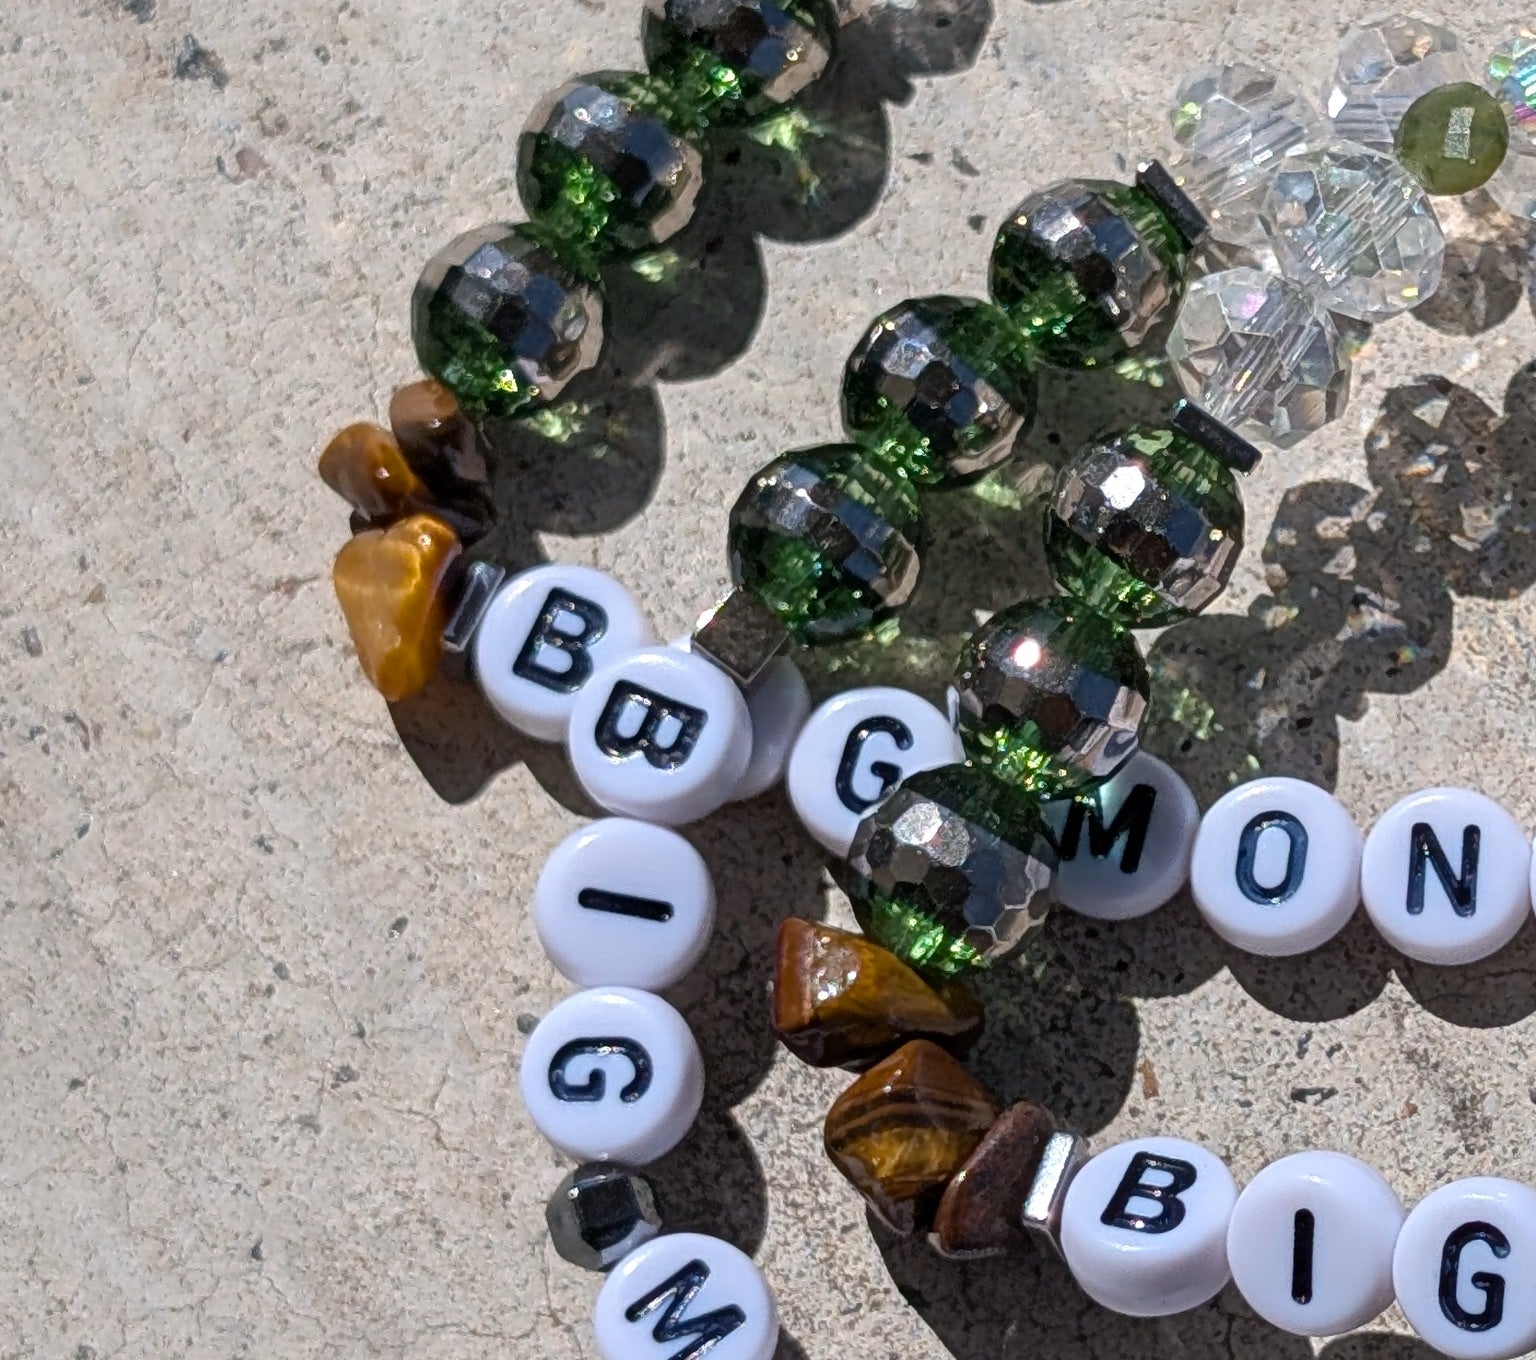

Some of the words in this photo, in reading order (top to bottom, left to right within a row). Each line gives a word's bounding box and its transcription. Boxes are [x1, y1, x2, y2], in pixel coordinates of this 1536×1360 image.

[511, 586, 915, 814] BG
[547, 679, 708, 1103] BIG
[1100, 1151, 1509, 1332] BIG
